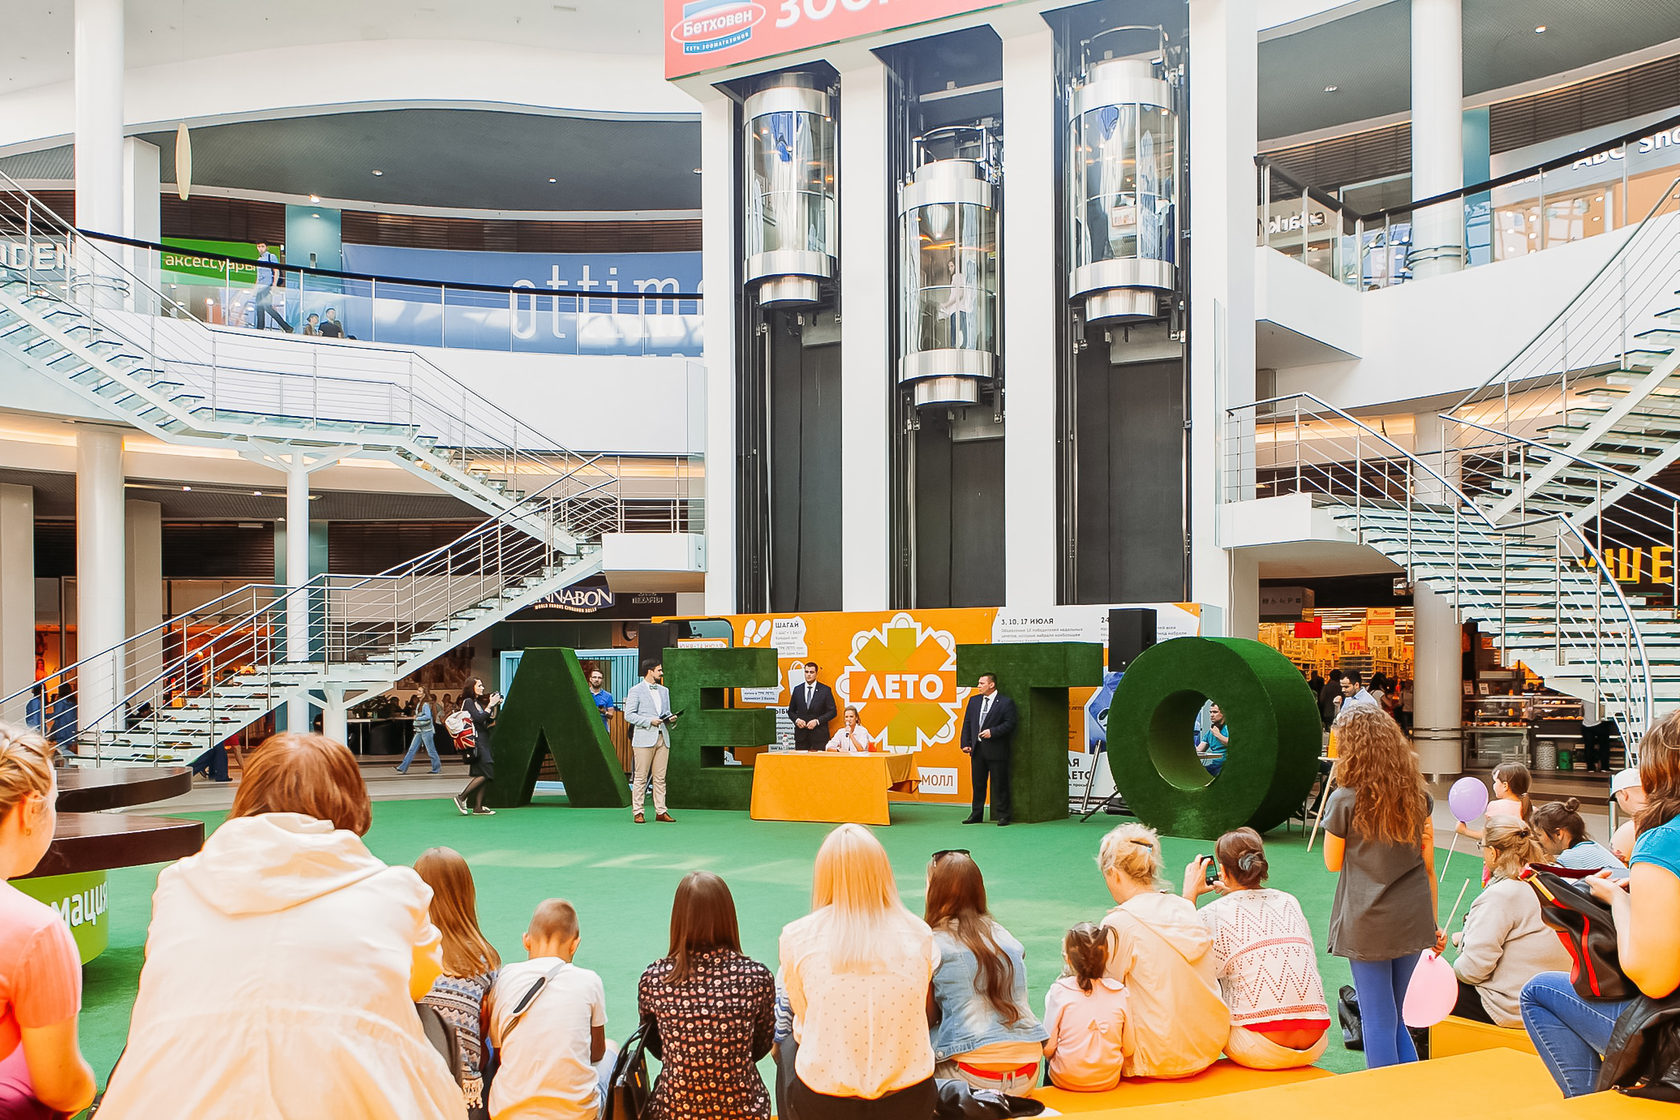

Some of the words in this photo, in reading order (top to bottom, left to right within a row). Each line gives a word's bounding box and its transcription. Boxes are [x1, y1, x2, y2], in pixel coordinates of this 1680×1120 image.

[683, 10, 753, 37] Бетховен
[775, 620, 799, 629] ШАГАЙ
[1030, 617, 1054, 625] ИЮЛЯ
[862, 673, 944, 700] ЛЕТО
[921, 774, 954, 787] МОЛЛ
